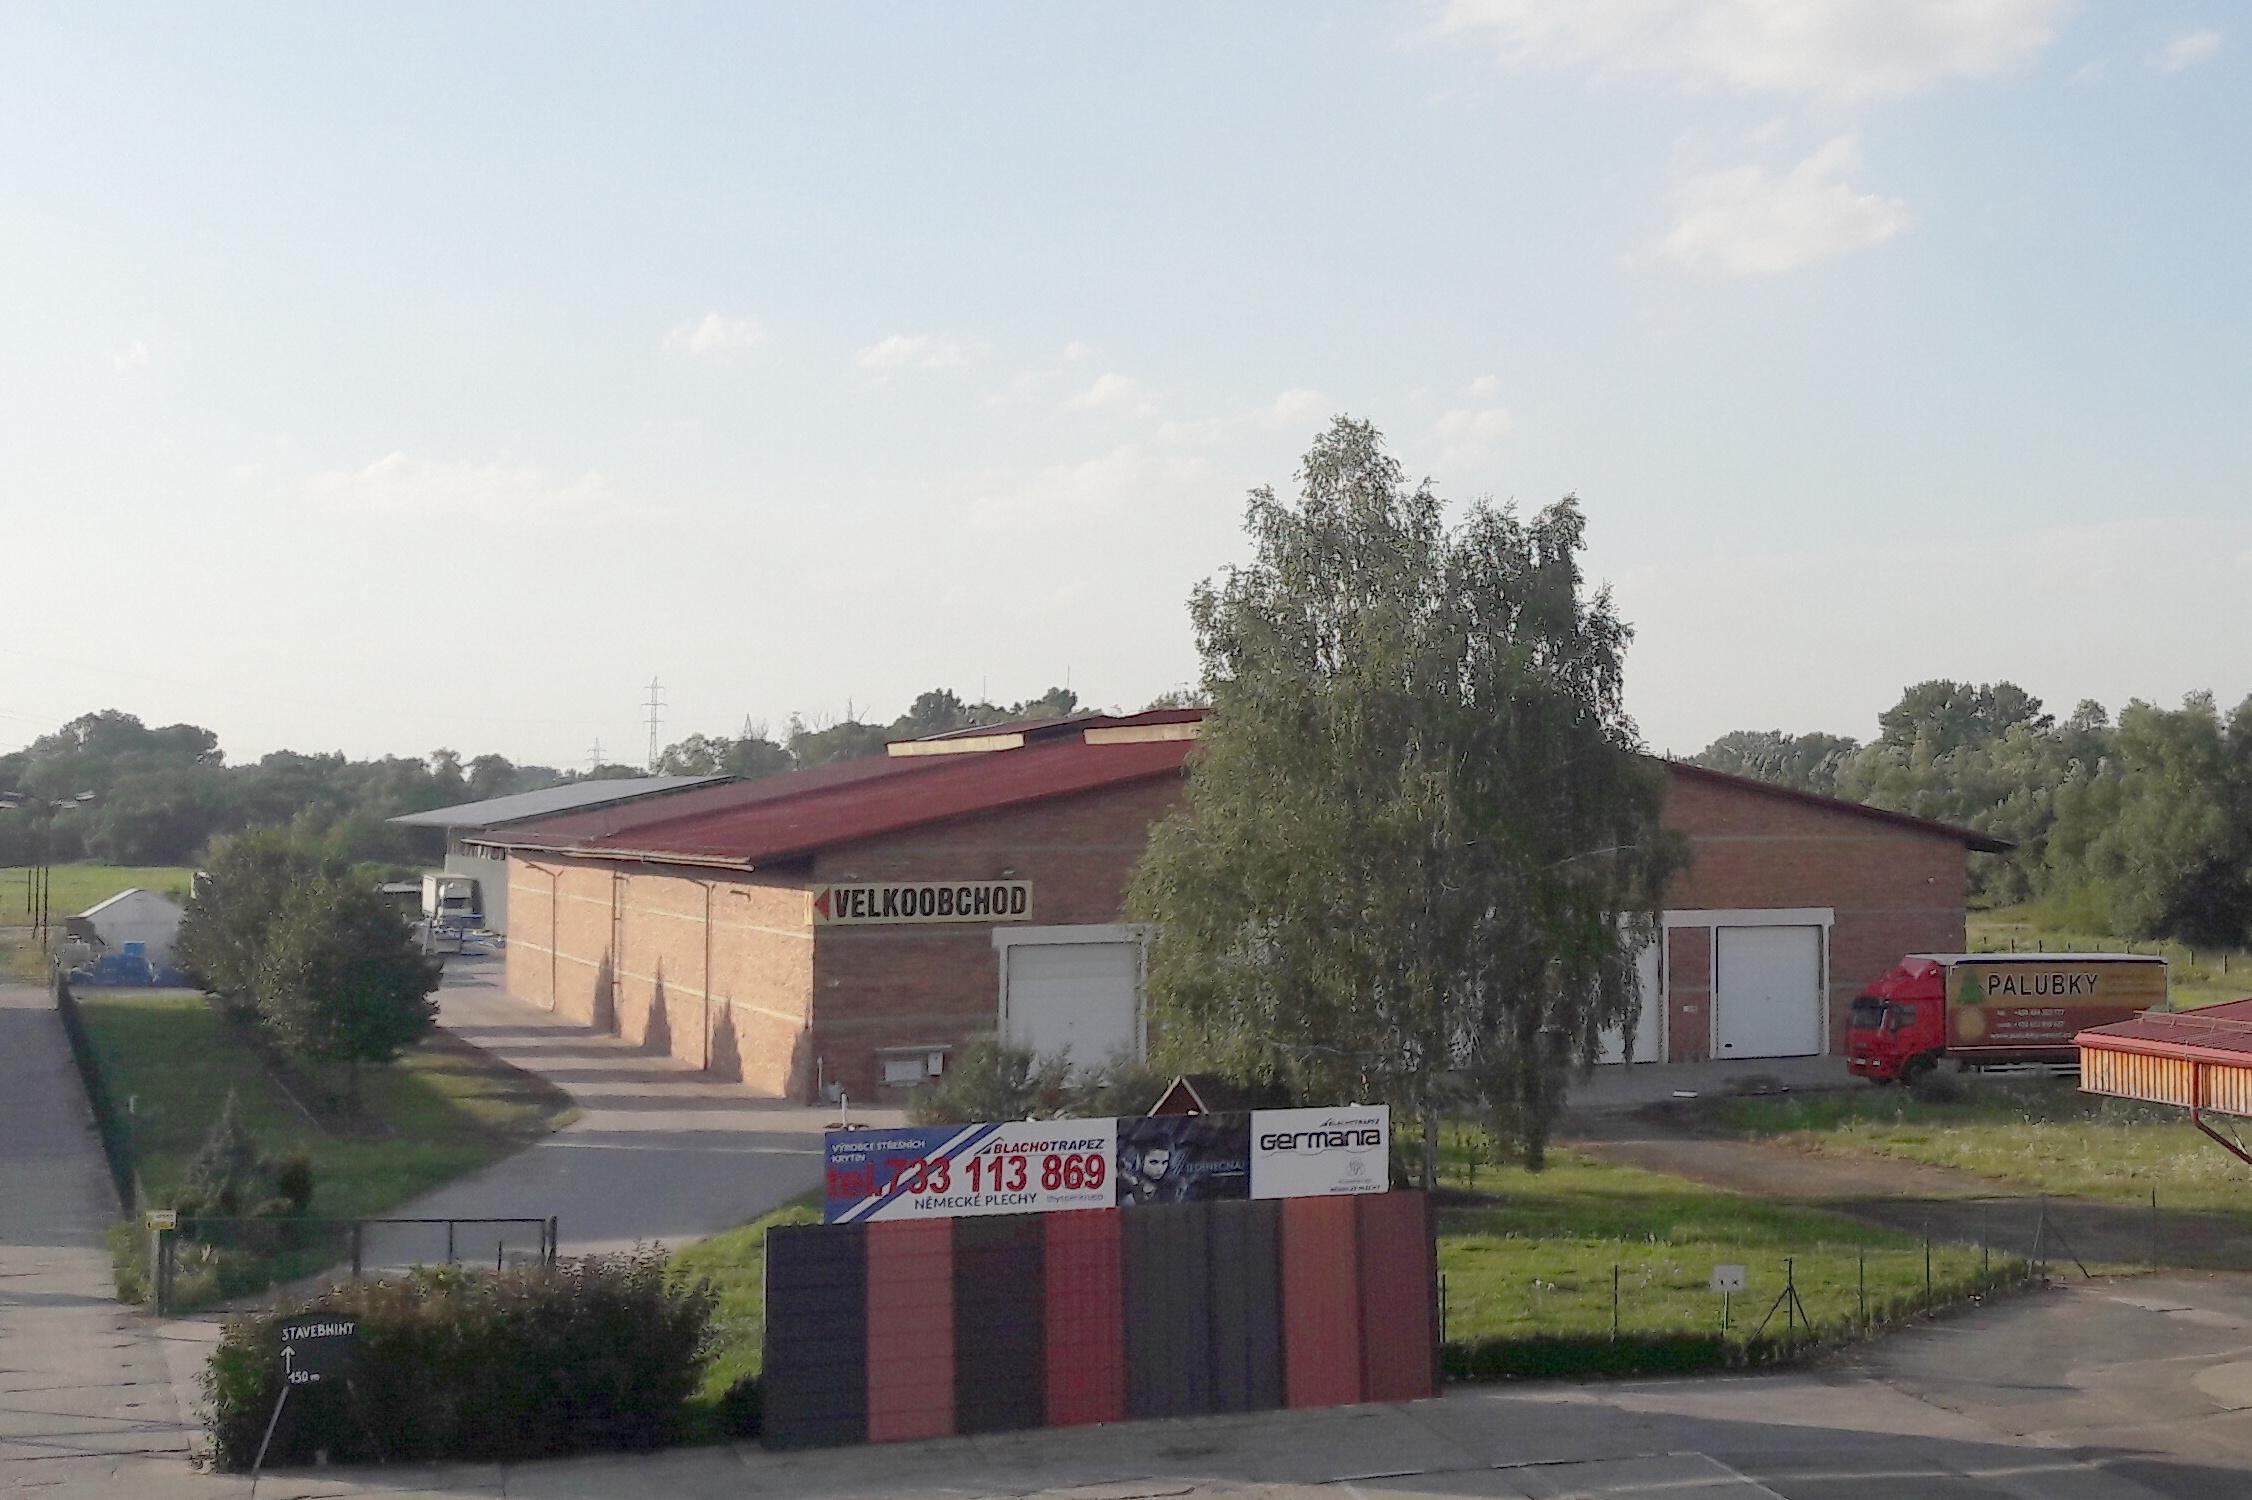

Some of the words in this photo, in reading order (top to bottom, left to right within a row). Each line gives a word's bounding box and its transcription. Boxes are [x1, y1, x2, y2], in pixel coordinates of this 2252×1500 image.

[834, 886, 1027, 918] VELKOOBCHOD
[1986, 973, 2099, 996] PALUBKY
[993, 1138, 1105, 1155] BLACHOTRAPEZ
[965, 1155, 1027, 1193] 113
[1041, 1153, 1105, 1191] 869
[985, 1192, 1037, 1206] PLECHY
[288, 1370, 309, 1384] 150
